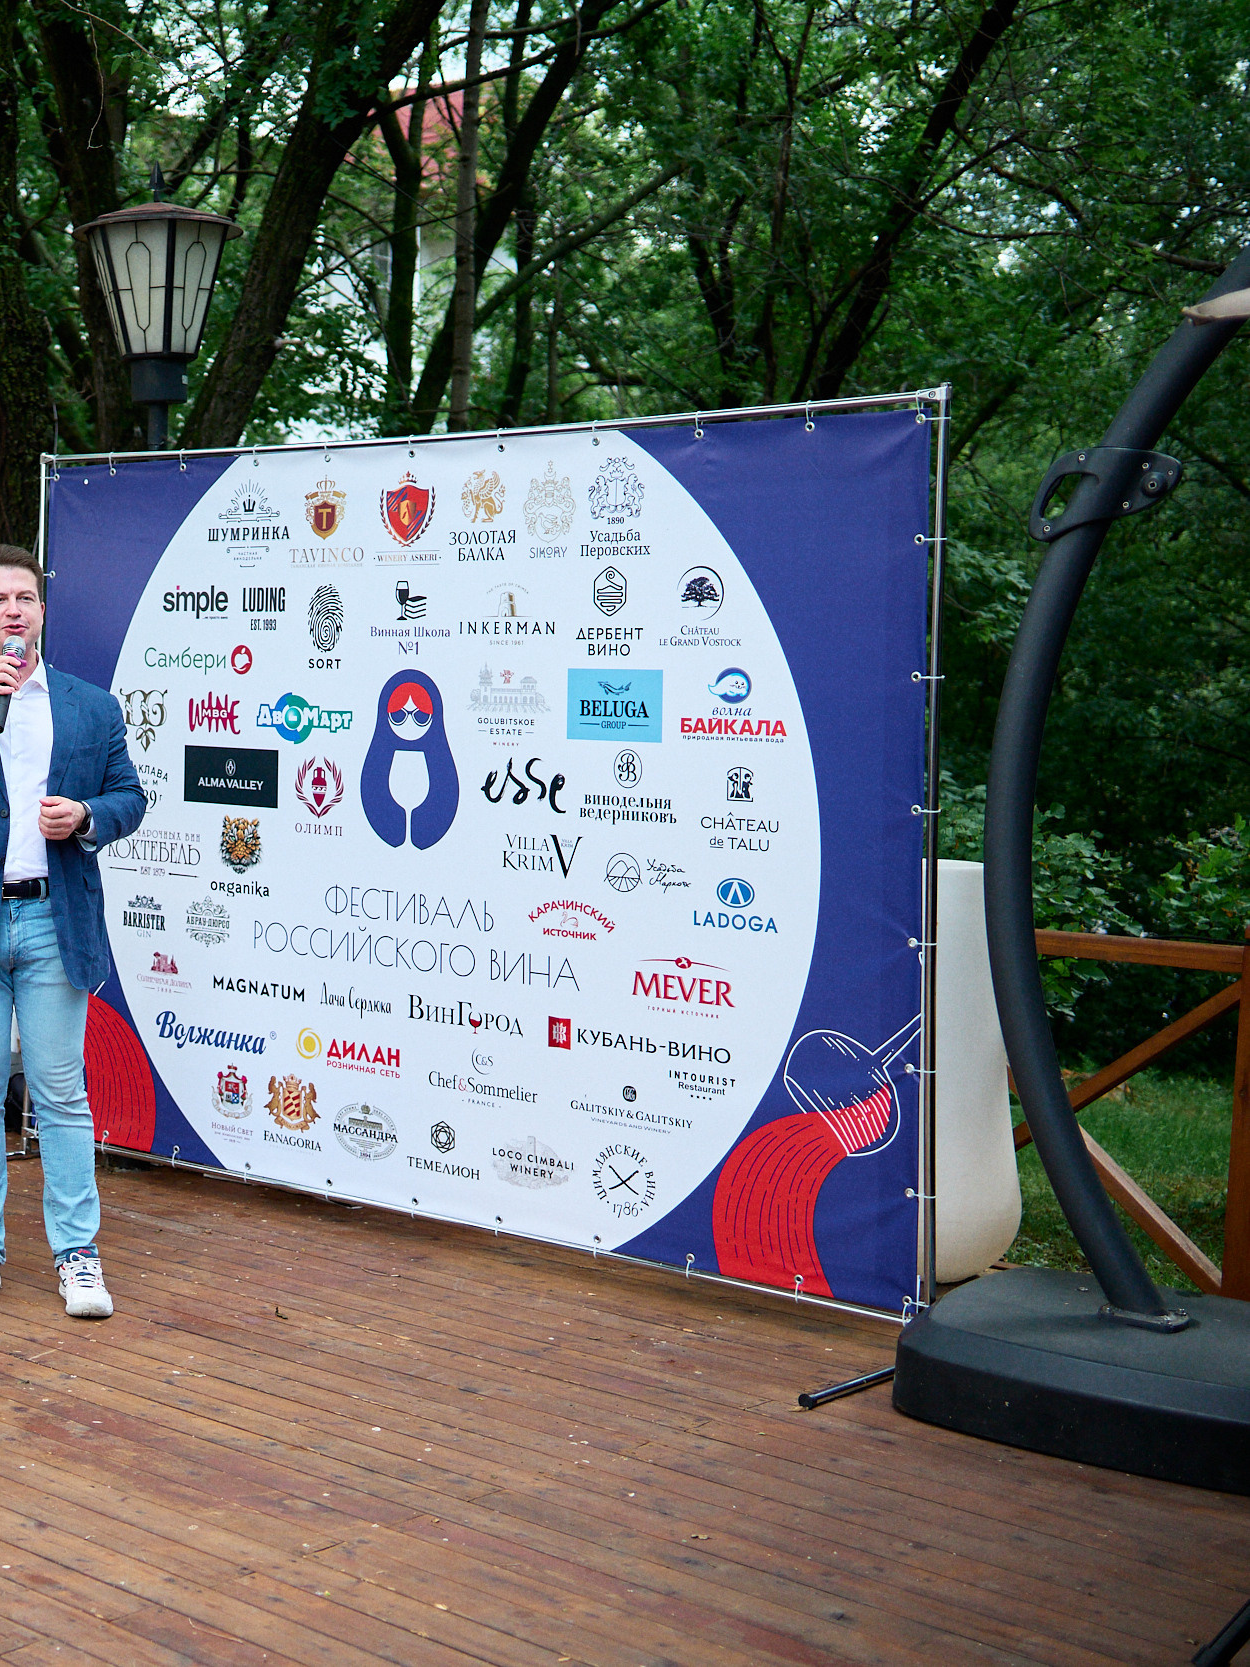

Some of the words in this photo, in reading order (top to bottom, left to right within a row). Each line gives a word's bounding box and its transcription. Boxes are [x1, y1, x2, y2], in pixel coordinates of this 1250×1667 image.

[607, 516, 625, 525] 1890
[208, 526, 290, 541] ШУМРИНКА
[449, 530, 516, 545] ЗОЛОТАЯ
[590, 529, 641, 544] Усадьба
[289, 547, 364, 563] TAVINCO
[377, 554, 408, 562] WINERY
[410, 553, 437, 562] ASKERI
[458, 546, 505, 561] БАЛКА
[529, 546, 568, 558] SIKORY
[580, 544, 651, 559] Перовских
[163, 585, 228, 619] simple
[242, 587, 286, 612] LUDING
[250, 619, 262, 631] EST.
[263, 618, 277, 631] 1993
[370, 626, 411, 638] Винная
[414, 626, 451, 639] Школа
[459, 621, 556, 635] INKERMAN
[575, 627, 644, 641] ДЕРБЕНТ
[398, 641, 419, 655] №1
[587, 643, 631, 656] ВИНО
[144, 646, 227, 675] Самбери
[308, 658, 342, 670] SORT
[202, 708, 228, 718] MBG
[579, 699, 650, 719] BELUGA
[712, 706, 753, 717] волна
[478, 717, 535, 726] GOLUBITSKOE
[600, 720, 627, 730] GROUP
[680, 717, 787, 737] БАЙКАЛА
[489, 728, 523, 736] ESTATE
[198, 776, 226, 788] ALMA
[226, 778, 264, 791] VALLEY
[584, 793, 672, 810] винодельня
[579, 807, 677, 825] ведерниковъ
[700, 812, 780, 833] CHÂTEAU
[294, 822, 343, 836] ОЛИМП
[506, 833, 550, 851] VILLA
[710, 836, 724, 848] de
[728, 836, 770, 852] TALU
[502, 850, 554, 872] KRIM
[646, 858, 686, 873] Усадьба
[324, 884, 494, 932] ФЕСТИВАЛЬ
[528, 899, 616, 933] КАРАЧИНСКИЙ
[123, 911, 166, 931] BARRISTER
[693, 910, 778, 934] LADOGA
[136, 929, 151, 938] GIN
[542, 927, 597, 941] ИСТОЧНИК
[254, 919, 476, 977] РОССИЙСКОГО
[490, 948, 580, 992] ВИНА
[213, 975, 305, 1002] MAGNATUM
[632, 970, 735, 1008] MEVER
[320, 981, 345, 1007] Дача
[348, 986, 392, 1019] Сердюка
[155, 1010, 267, 1055] Волжанка
[327, 1038, 401, 1068] ДИЛАН
[577, 1028, 731, 1064] КУБАНЬ-ВИНО
[326, 1059, 377, 1075] РОЗНИЧНАЯ
[379, 1067, 401, 1079] СЕТЬ
[669, 1070, 736, 1087] INTOURIST
[678, 1081, 726, 1096] Restaurant
[263, 1130, 322, 1152] FANAGORIA
[333, 1122, 399, 1144] МАССАНДРА
[492, 1147, 522, 1160] LOCO
[527, 1154, 574, 1171] CIMBALI
[406, 1155, 480, 1181] ТЕМЕЛИОН
[510, 1163, 555, 1179] WINERY
[592, 1143, 648, 1200] ЦИМЛЯНСКИЕ
[640, 1170, 656, 1207] ВИНА
[612, 1201, 639, 1218] 1786
